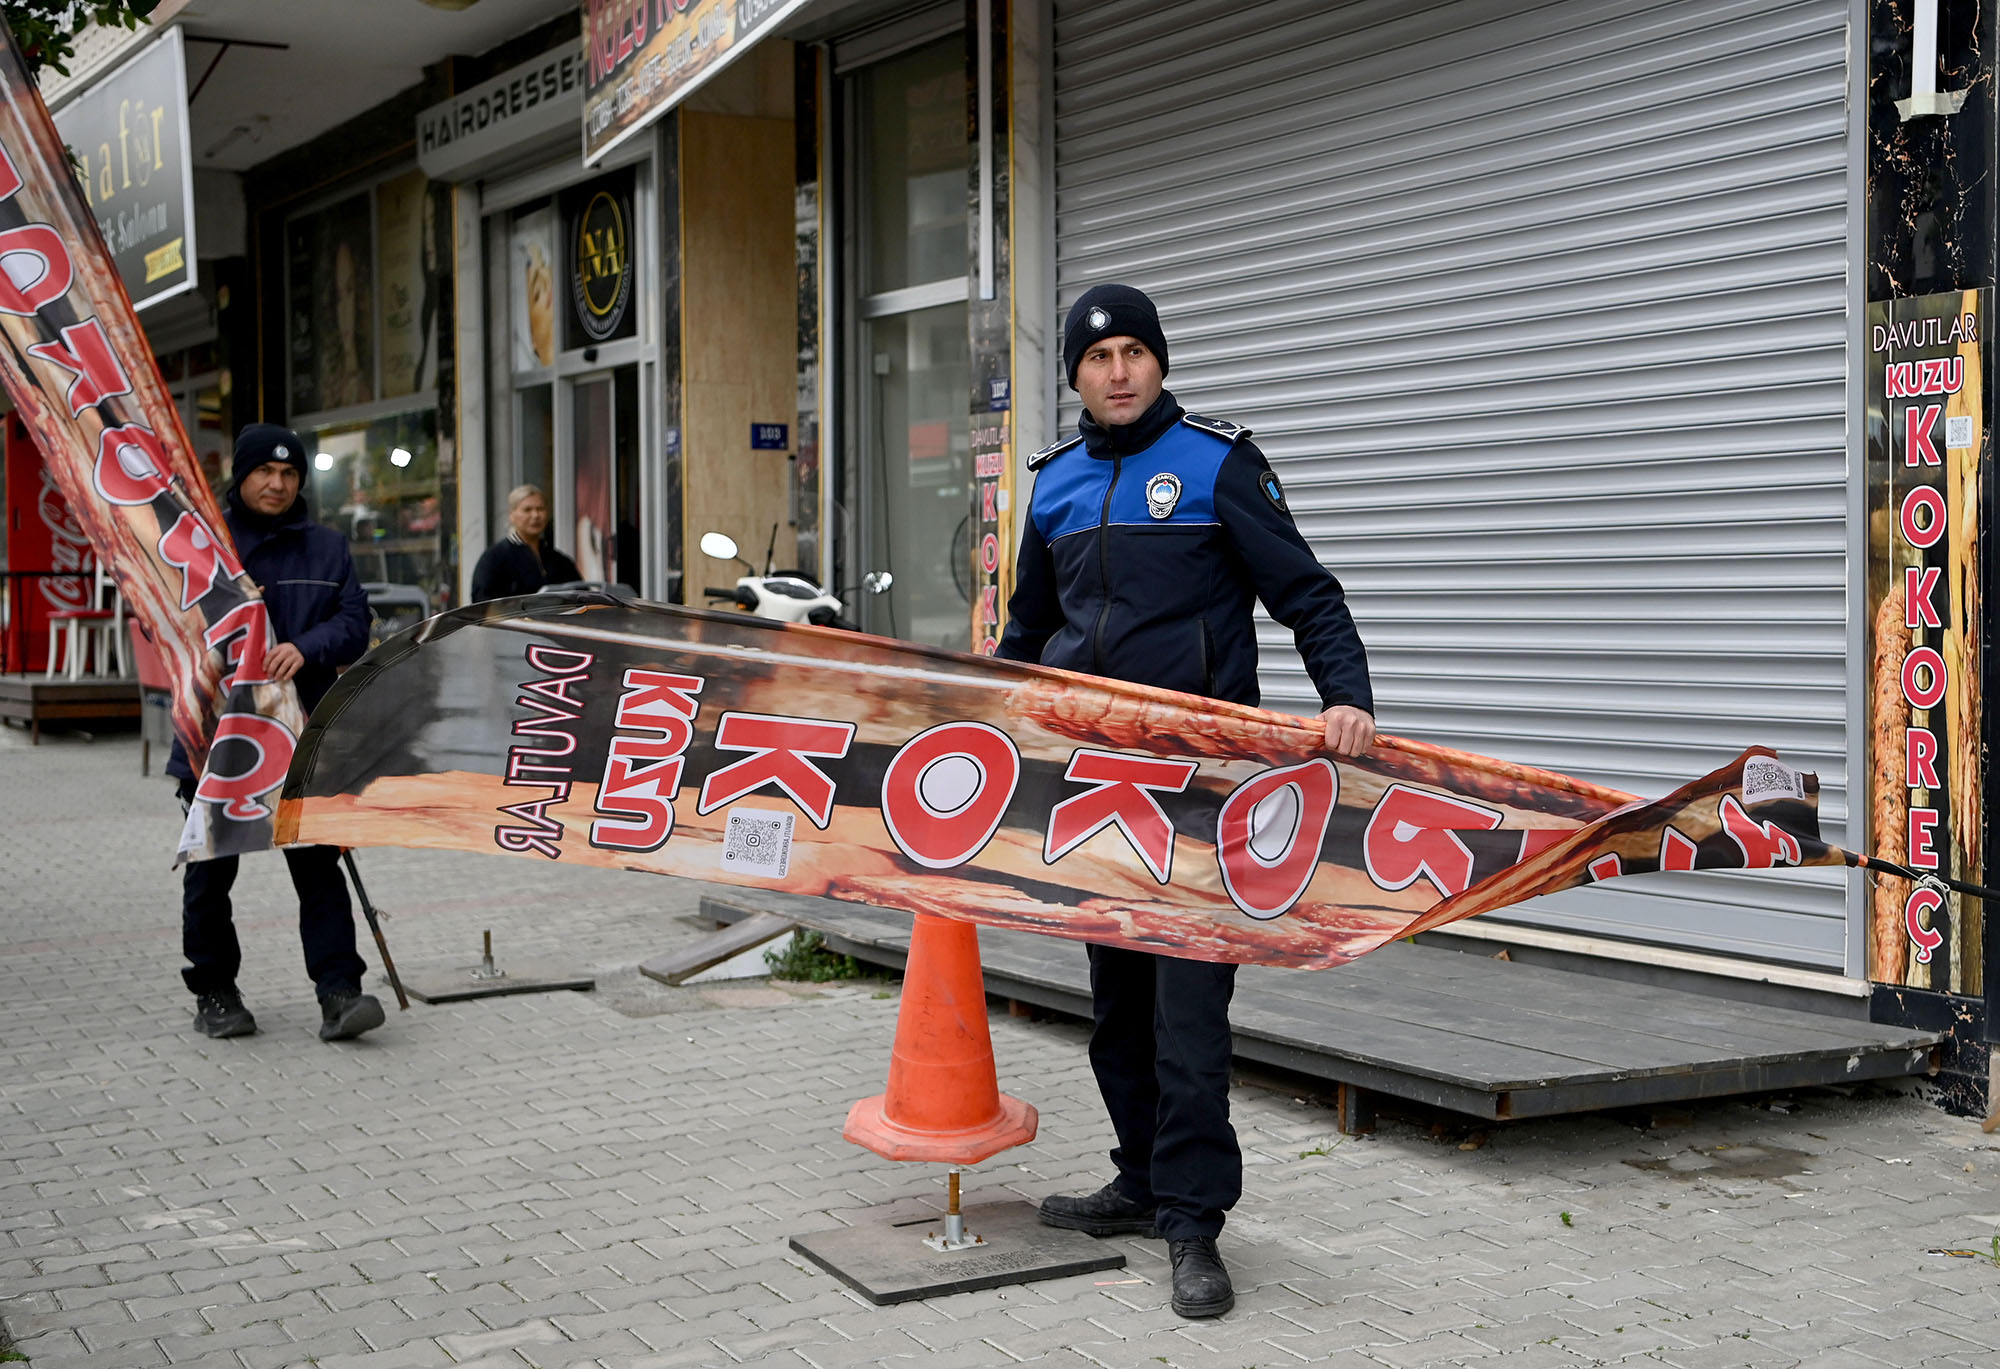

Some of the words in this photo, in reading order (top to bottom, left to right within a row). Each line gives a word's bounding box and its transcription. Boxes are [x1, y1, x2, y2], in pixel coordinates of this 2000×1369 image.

[1872, 312, 1978, 353] DAVUTLAR
[1885, 355, 1965, 400] KUZU
[971, 425, 1010, 449] DAVUTLAR
[975, 452, 1006, 477] KUZU
[1900, 402, 1948, 965] KOKOREÇ
